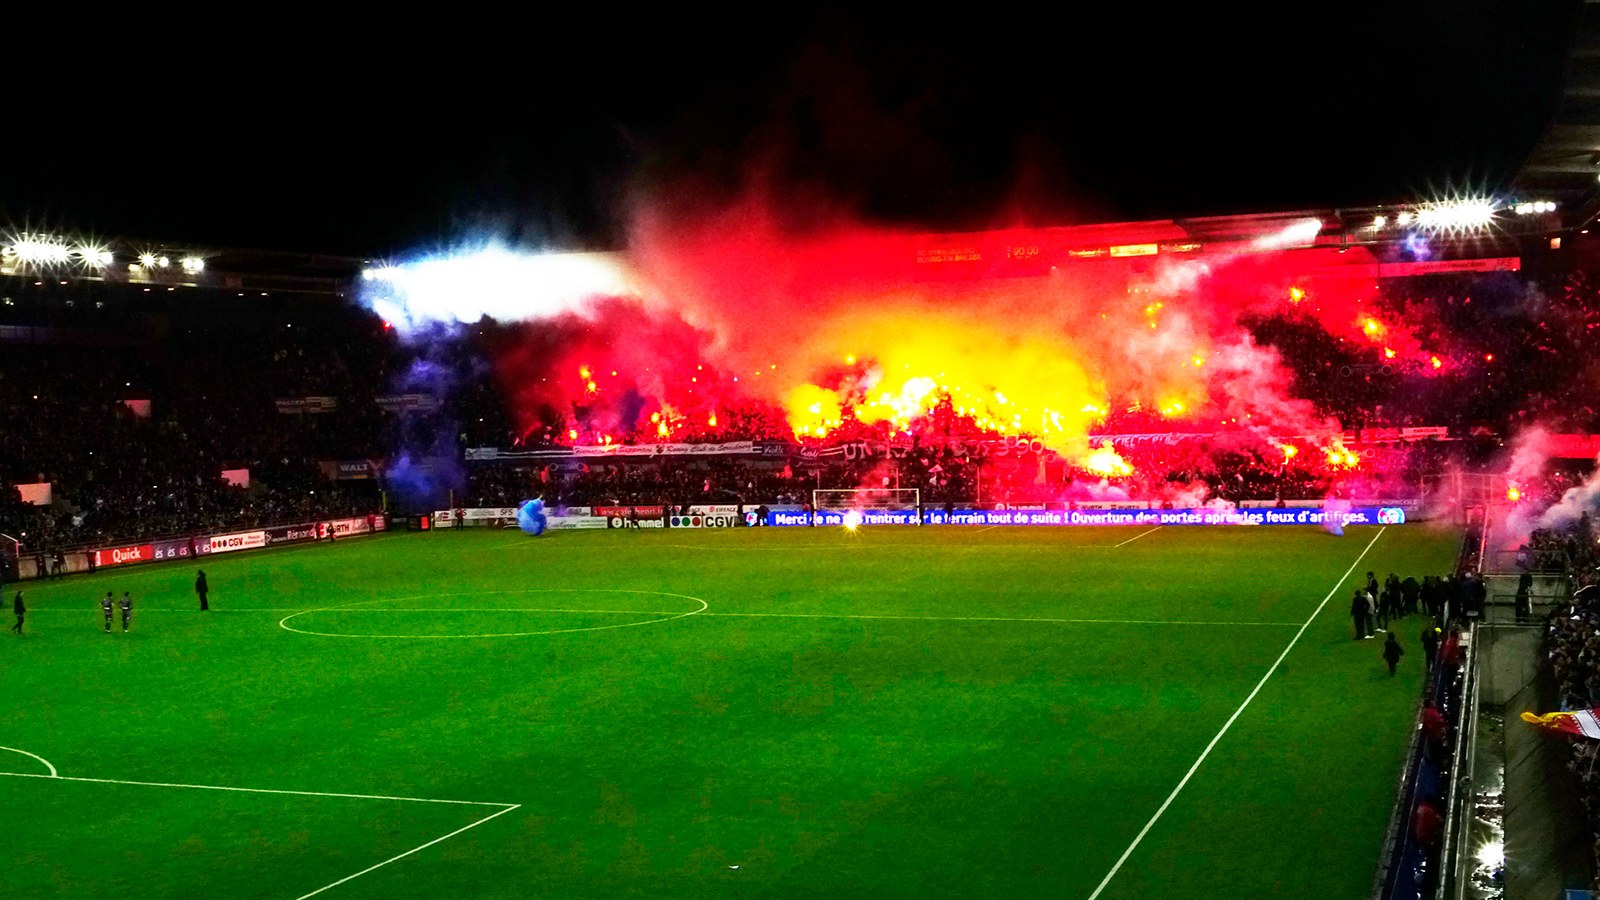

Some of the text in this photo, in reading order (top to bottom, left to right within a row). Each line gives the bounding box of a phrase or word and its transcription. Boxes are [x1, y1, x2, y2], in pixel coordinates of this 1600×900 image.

[705, 516, 735, 528] CGV
[775, 512, 808, 525] Merci
[825, 515, 841, 525] ne
[865, 514, 908, 525] rentrer
[908, 515, 929, 525] sr
[930, 512, 943, 524] le
[987, 513, 1011, 524] tout
[1015, 511, 1029, 524] de
[1030, 511, 1062, 524] suite
[1071, 511, 1134, 524] Ouverture
[1161, 513, 1203, 524] portes
[1243, 511, 1264, 523] les
[1266, 510, 1296, 523] feux
[228, 536, 244, 548] CGV
[112, 547, 141, 563] Quick
